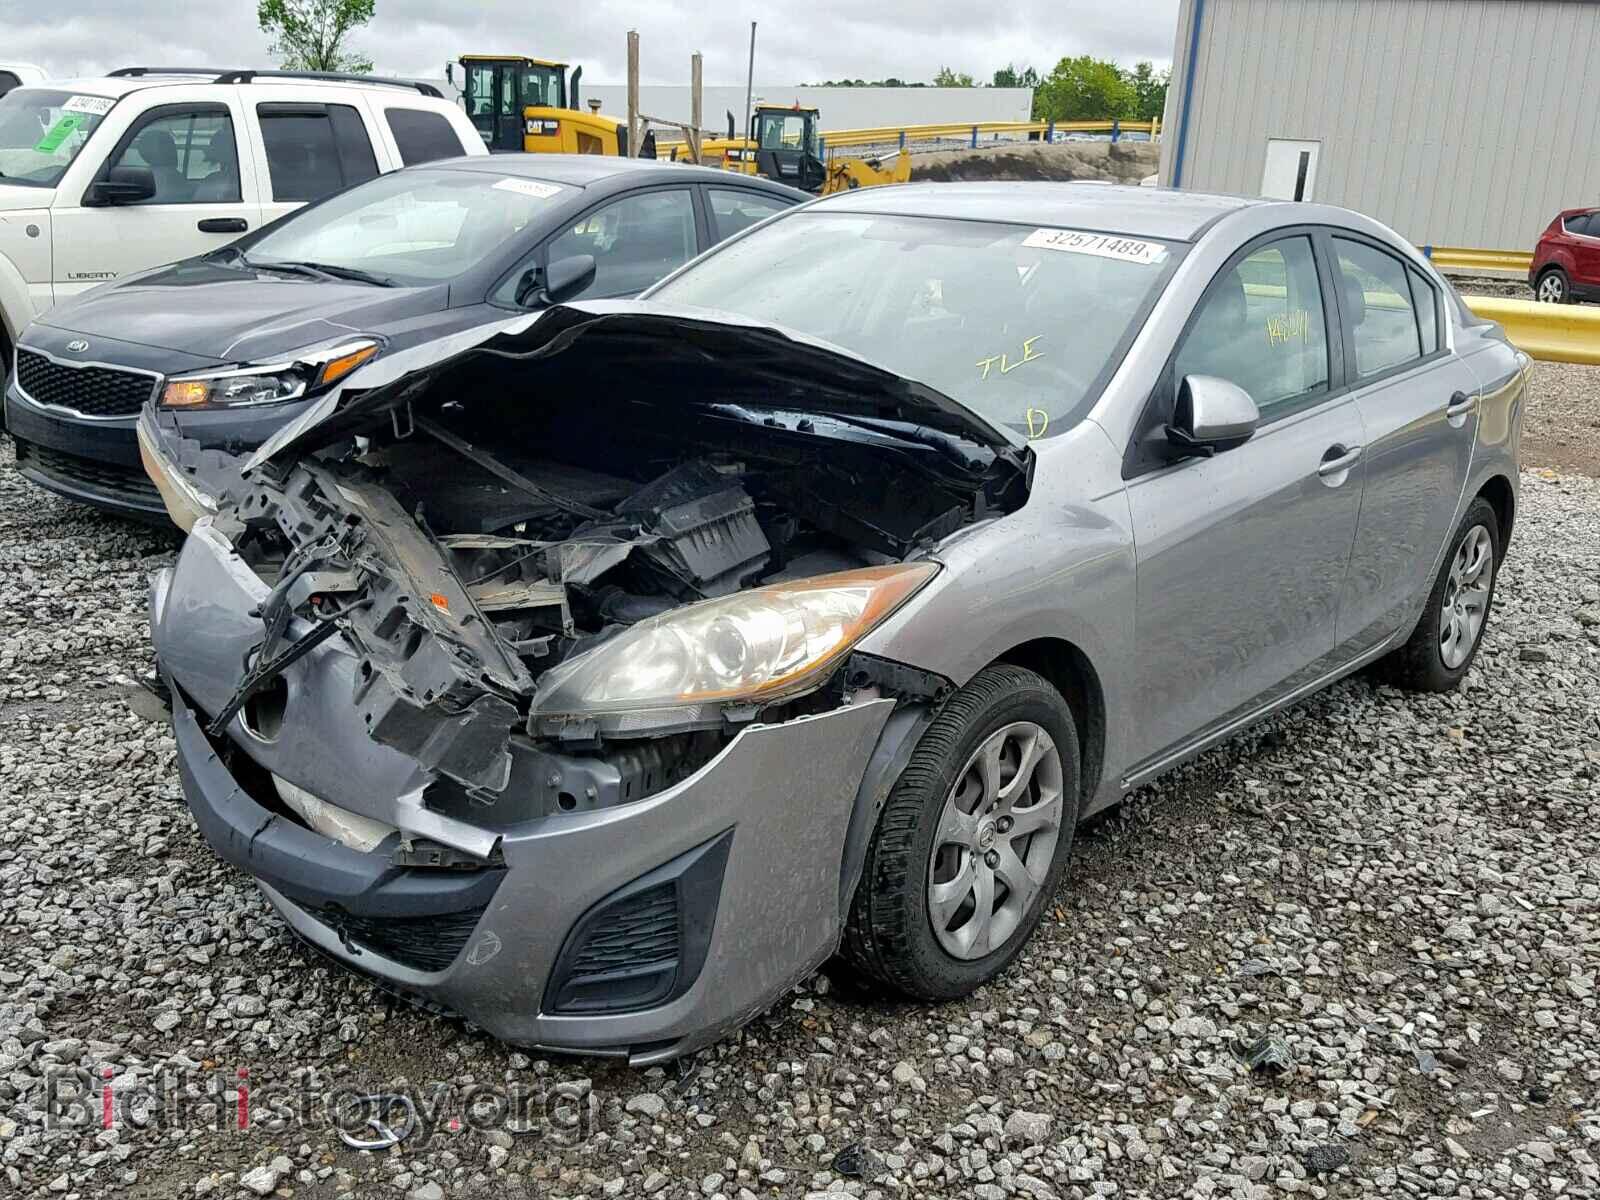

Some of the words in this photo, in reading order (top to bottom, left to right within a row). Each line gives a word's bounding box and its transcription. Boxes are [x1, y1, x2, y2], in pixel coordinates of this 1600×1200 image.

[527, 120, 543, 134] CAT
[1046, 231, 1147, 257] 32571489
[67, 272, 119, 280] LIBERTY
[975, 334, 1046, 380] TLE
[1026, 407, 1048, 439] D
